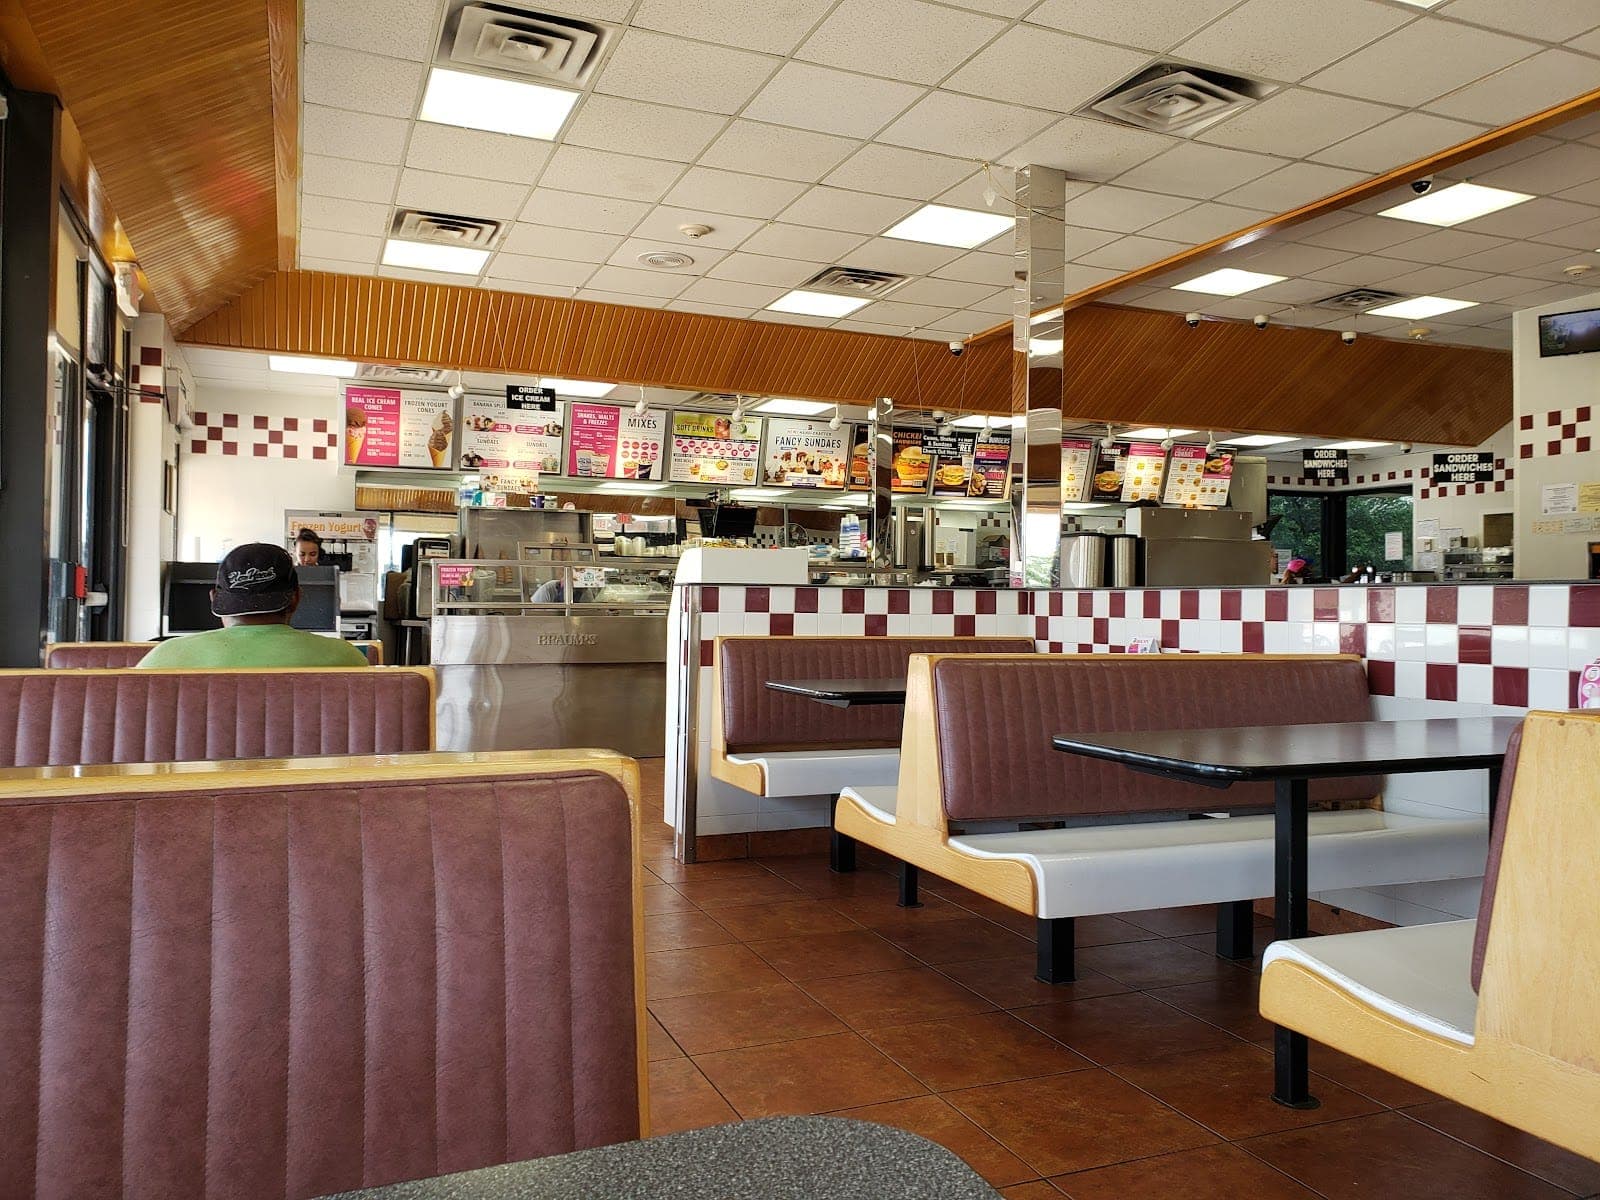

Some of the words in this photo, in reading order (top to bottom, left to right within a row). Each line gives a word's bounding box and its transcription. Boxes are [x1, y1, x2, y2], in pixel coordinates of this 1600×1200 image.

[628, 418, 656, 428] MIXES
[775, 436, 802, 446] FANCY
[804, 438, 842, 448] SUNDAES
[1314, 450, 1337, 458] ORDER
[1448, 454, 1479, 463] ORDER
[1304, 460, 1348, 468] SANDWICHES
[1434, 462, 1493, 472] SANDWICHES
[1318, 469, 1336, 478] HERE
[1451, 472, 1476, 482] HERE
[291, 521, 326, 532] Frozen
[328, 522, 362, 534] Yogurt
